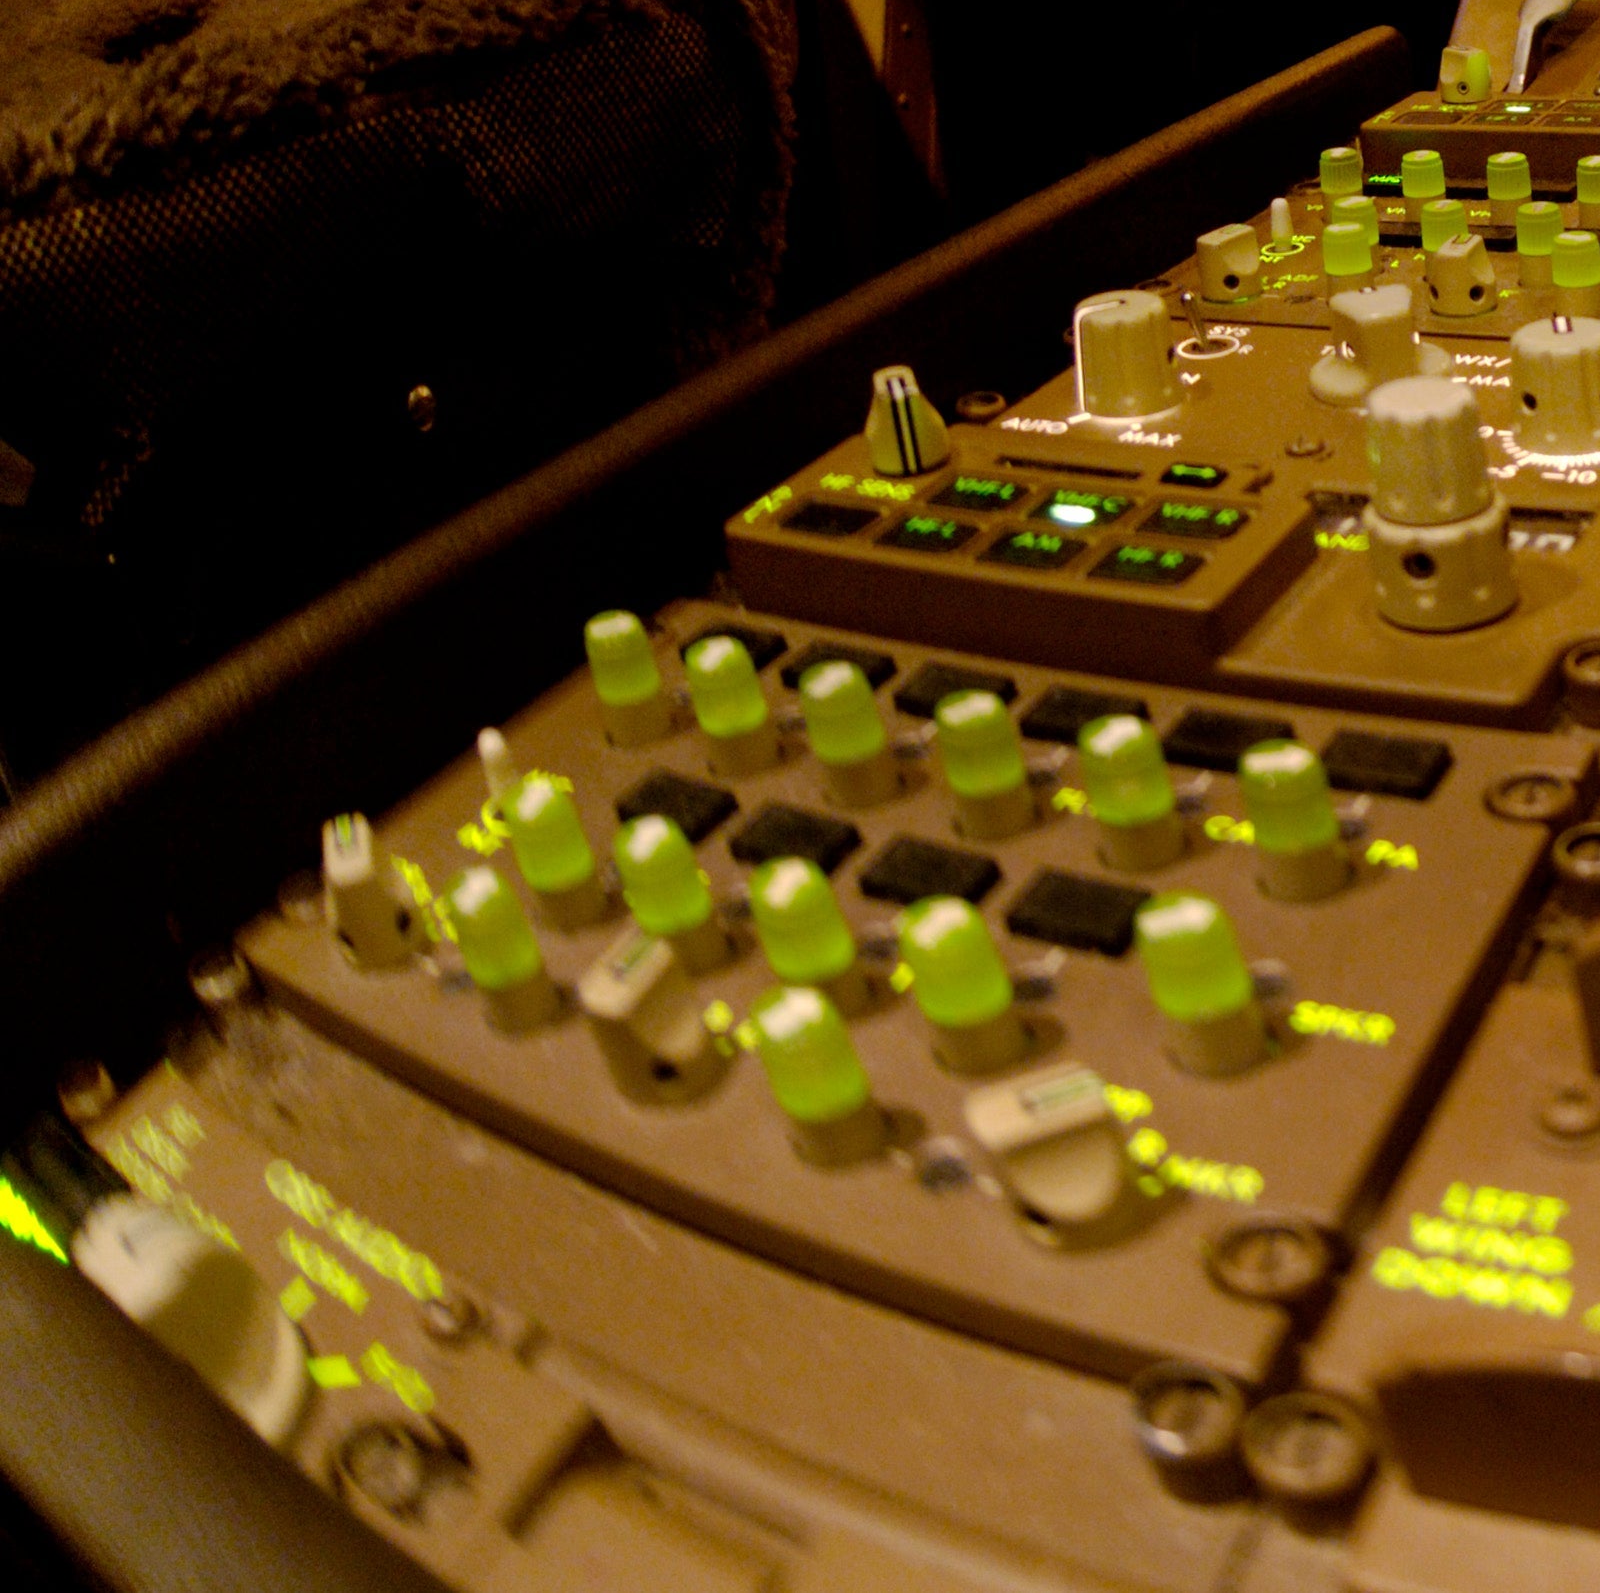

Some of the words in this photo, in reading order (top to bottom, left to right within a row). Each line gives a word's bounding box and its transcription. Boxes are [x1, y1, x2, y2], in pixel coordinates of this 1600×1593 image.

[1001, 417, 1068, 435] AUTO
[1118, 429, 1182, 448] MAX
[1440, 1181, 1571, 1233] LEFT
[1409, 1212, 1573, 1275] WING
[1371, 1247, 1574, 1319] DOWN
